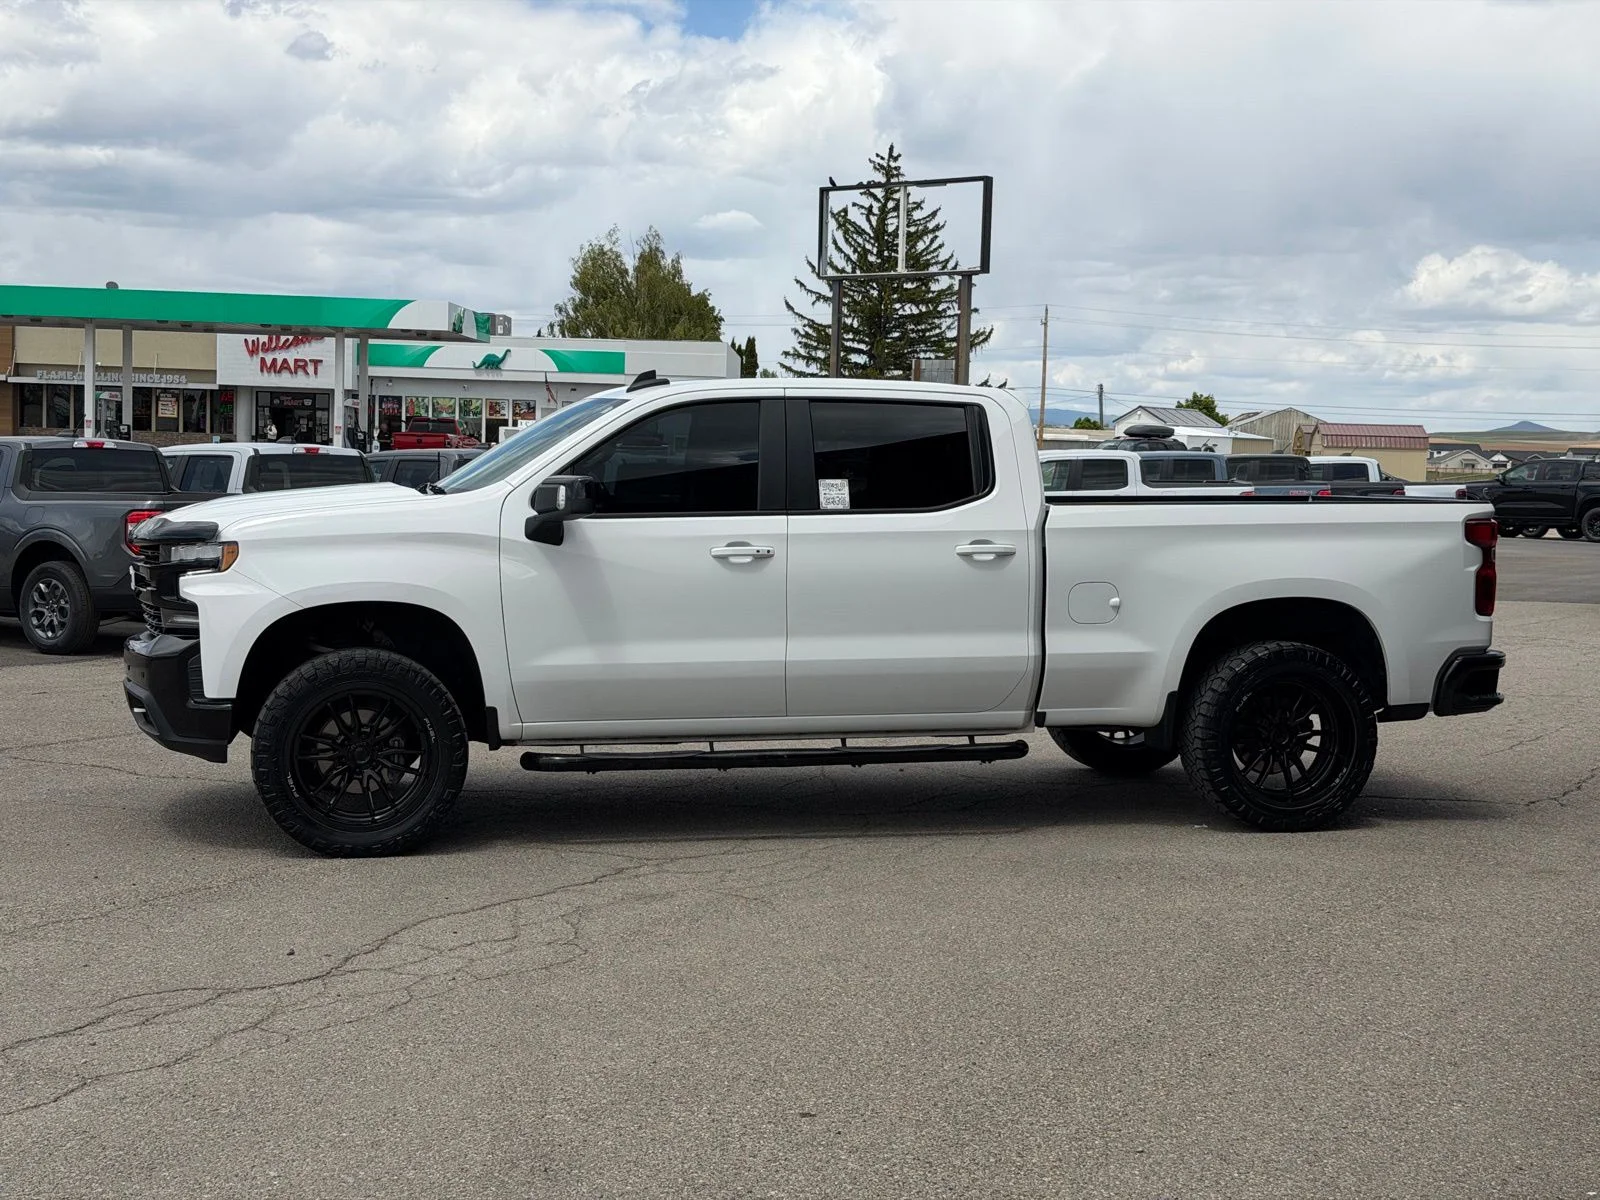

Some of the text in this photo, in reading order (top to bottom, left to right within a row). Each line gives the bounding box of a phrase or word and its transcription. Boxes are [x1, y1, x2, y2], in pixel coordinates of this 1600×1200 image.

[243, 335, 325, 357] Wellco
[260, 357, 323, 375] MART
[36, 370, 74, 380] FLAME
[76, 371, 123, 382] GLLIN
[162, 374, 188, 384] 1954
[423, 718, 436, 744] FUEL
